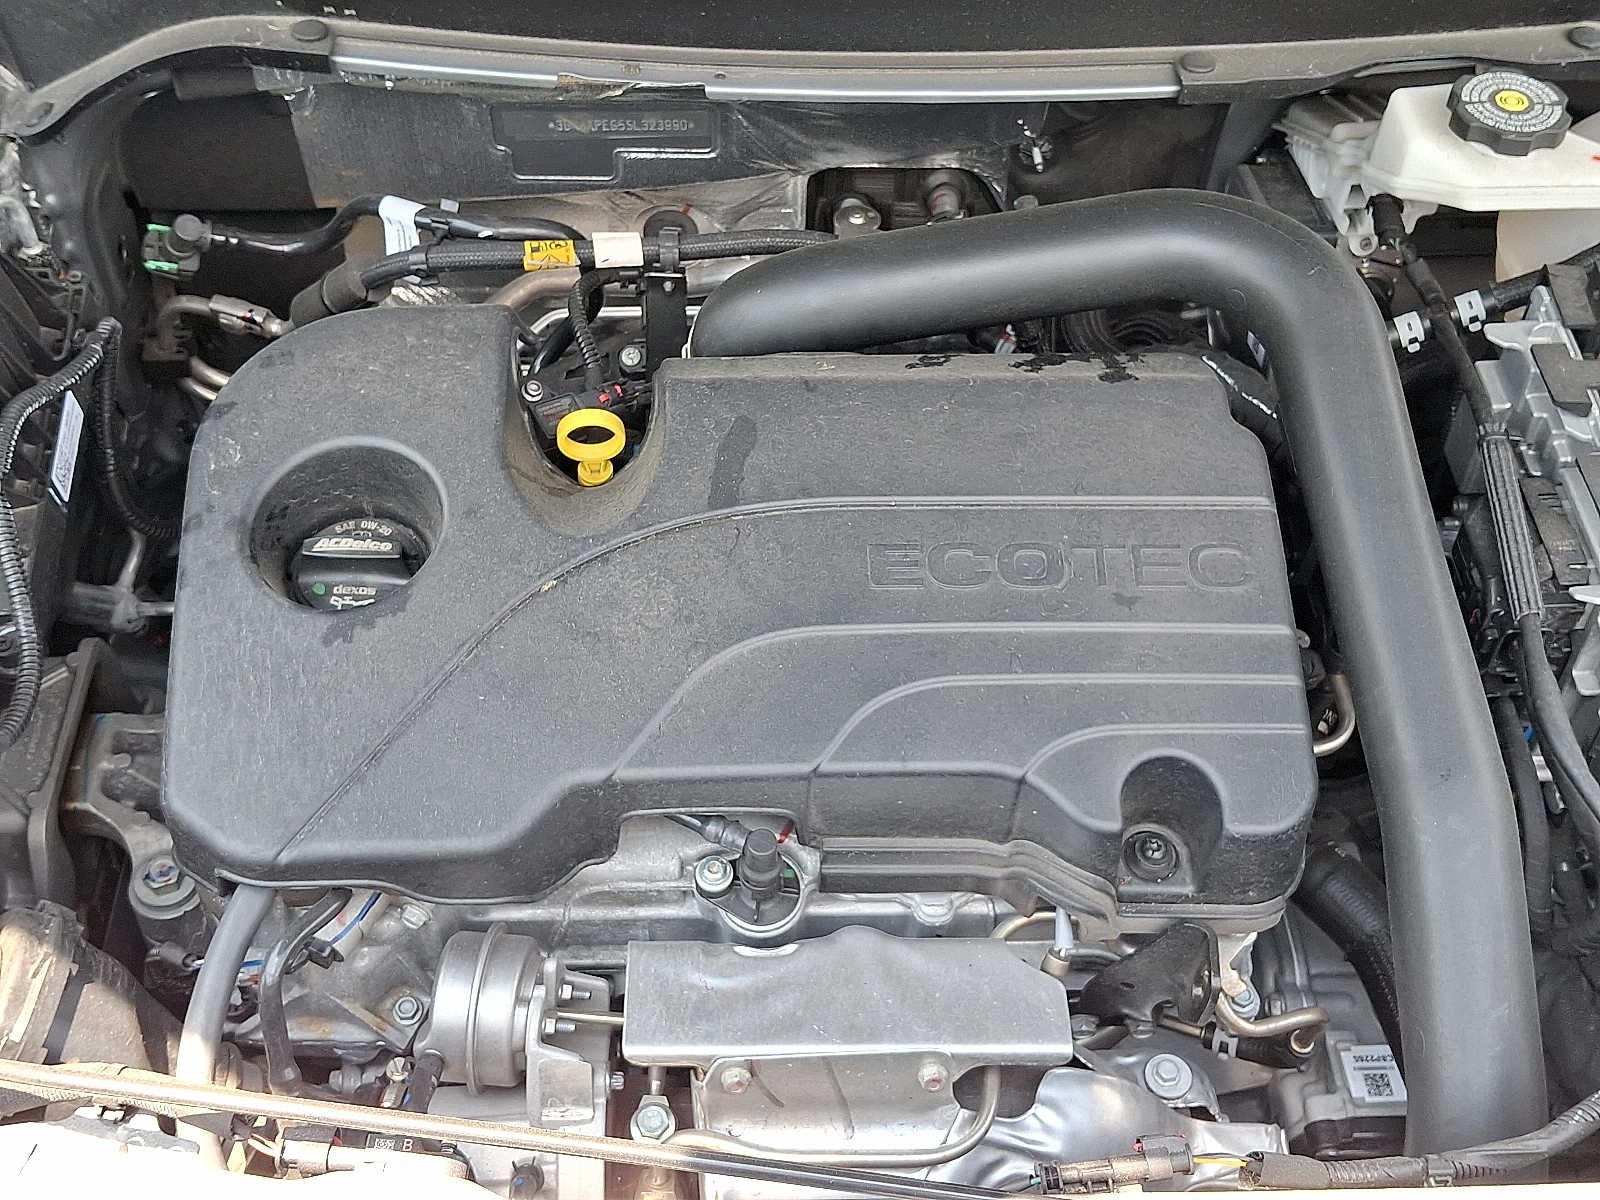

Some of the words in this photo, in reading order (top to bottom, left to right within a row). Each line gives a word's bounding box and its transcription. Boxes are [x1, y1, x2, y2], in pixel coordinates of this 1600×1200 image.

[334, 520, 355, 534] SAE
[312, 537, 393, 551] ACDelco
[866, 542, 1253, 591] ECOTEC
[333, 584, 376, 595] dexos
